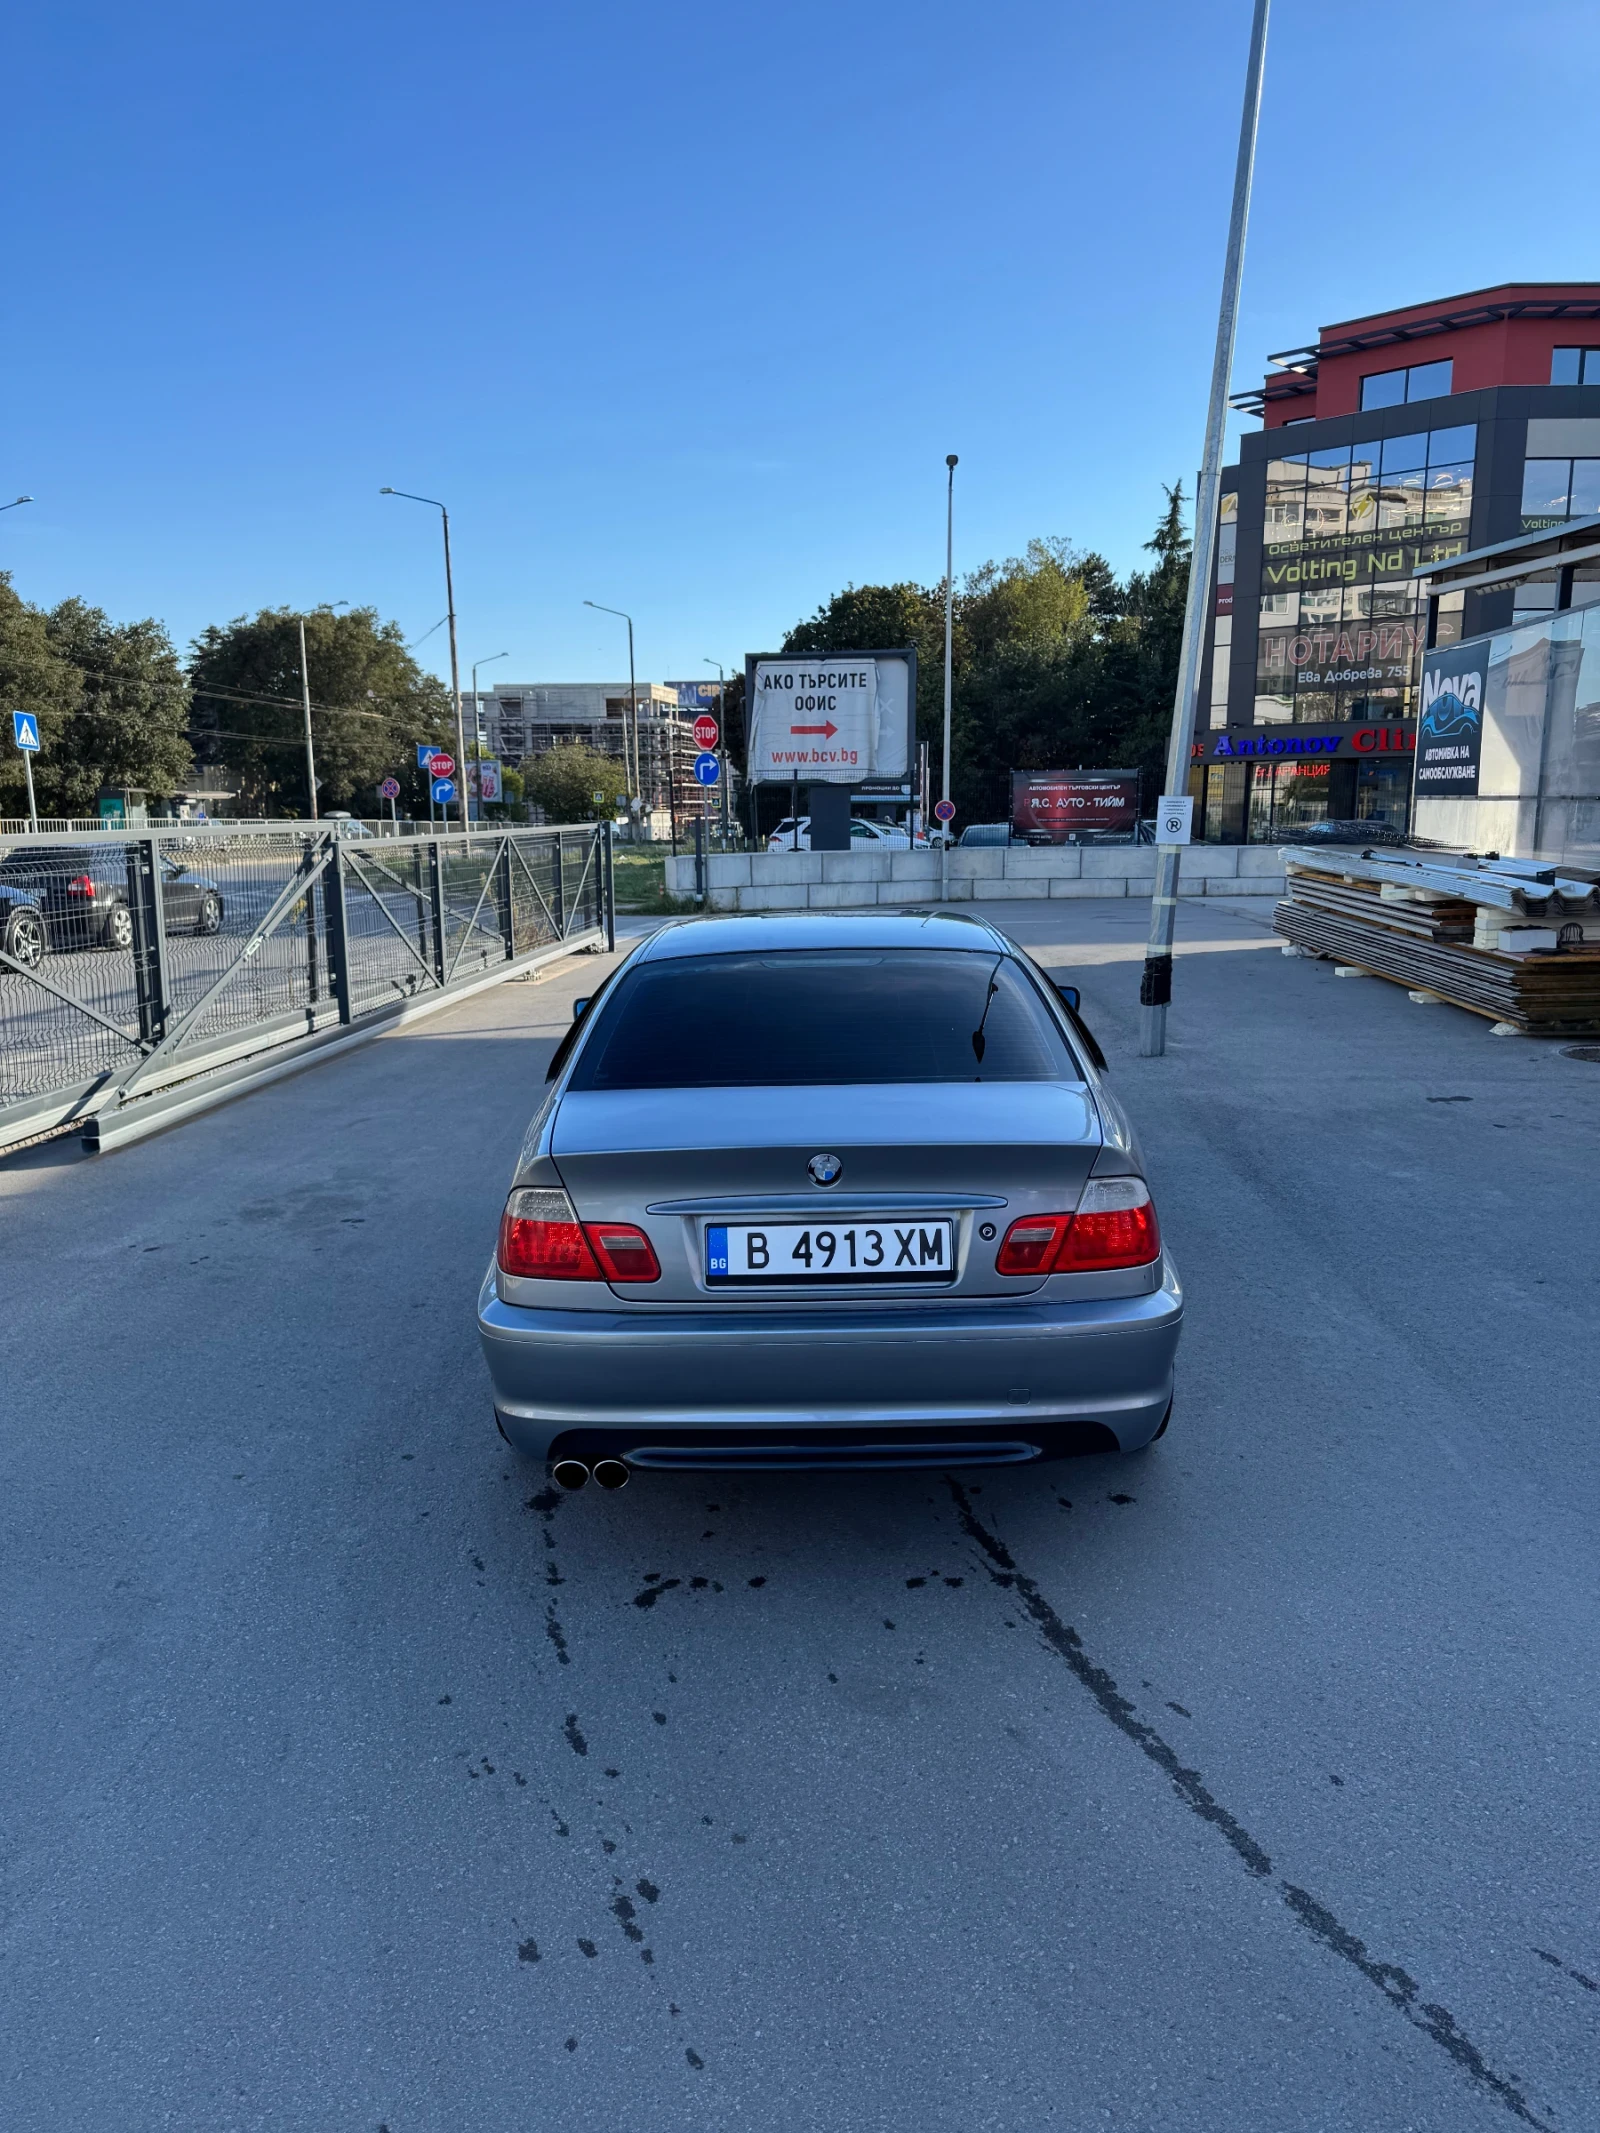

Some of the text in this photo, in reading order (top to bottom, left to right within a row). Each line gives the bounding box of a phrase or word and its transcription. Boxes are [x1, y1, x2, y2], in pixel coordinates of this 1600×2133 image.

[1269, 522, 1462, 555] Осветителен център
[1267, 557, 1357, 584] Volting
[1368, 549, 1402, 573] Nd
[764, 673, 867, 690] АКО ТЪРСИТЕ
[1298, 665, 1411, 684] Ева Добрева 755
[1422, 669, 1481, 720] Nova
[795, 695, 837, 712] ОФИС
[695, 727, 716, 739] STOP
[1213, 734, 1343, 756] Antonov
[1424, 745, 1470, 761] АВТОМИВКА НА
[772, 748, 858, 765] www.bcv.bg
[431, 761, 453, 770] STOP
[1419, 765, 1476, 780] САМООБСЛУЖВАНЕ
[1056, 797, 1085, 808] АУТО
[1093, 795, 1125, 808] ТИЙМ
[746, 1228, 943, 1269] B 4913 XM
[710, 1258, 727, 1269] BG
